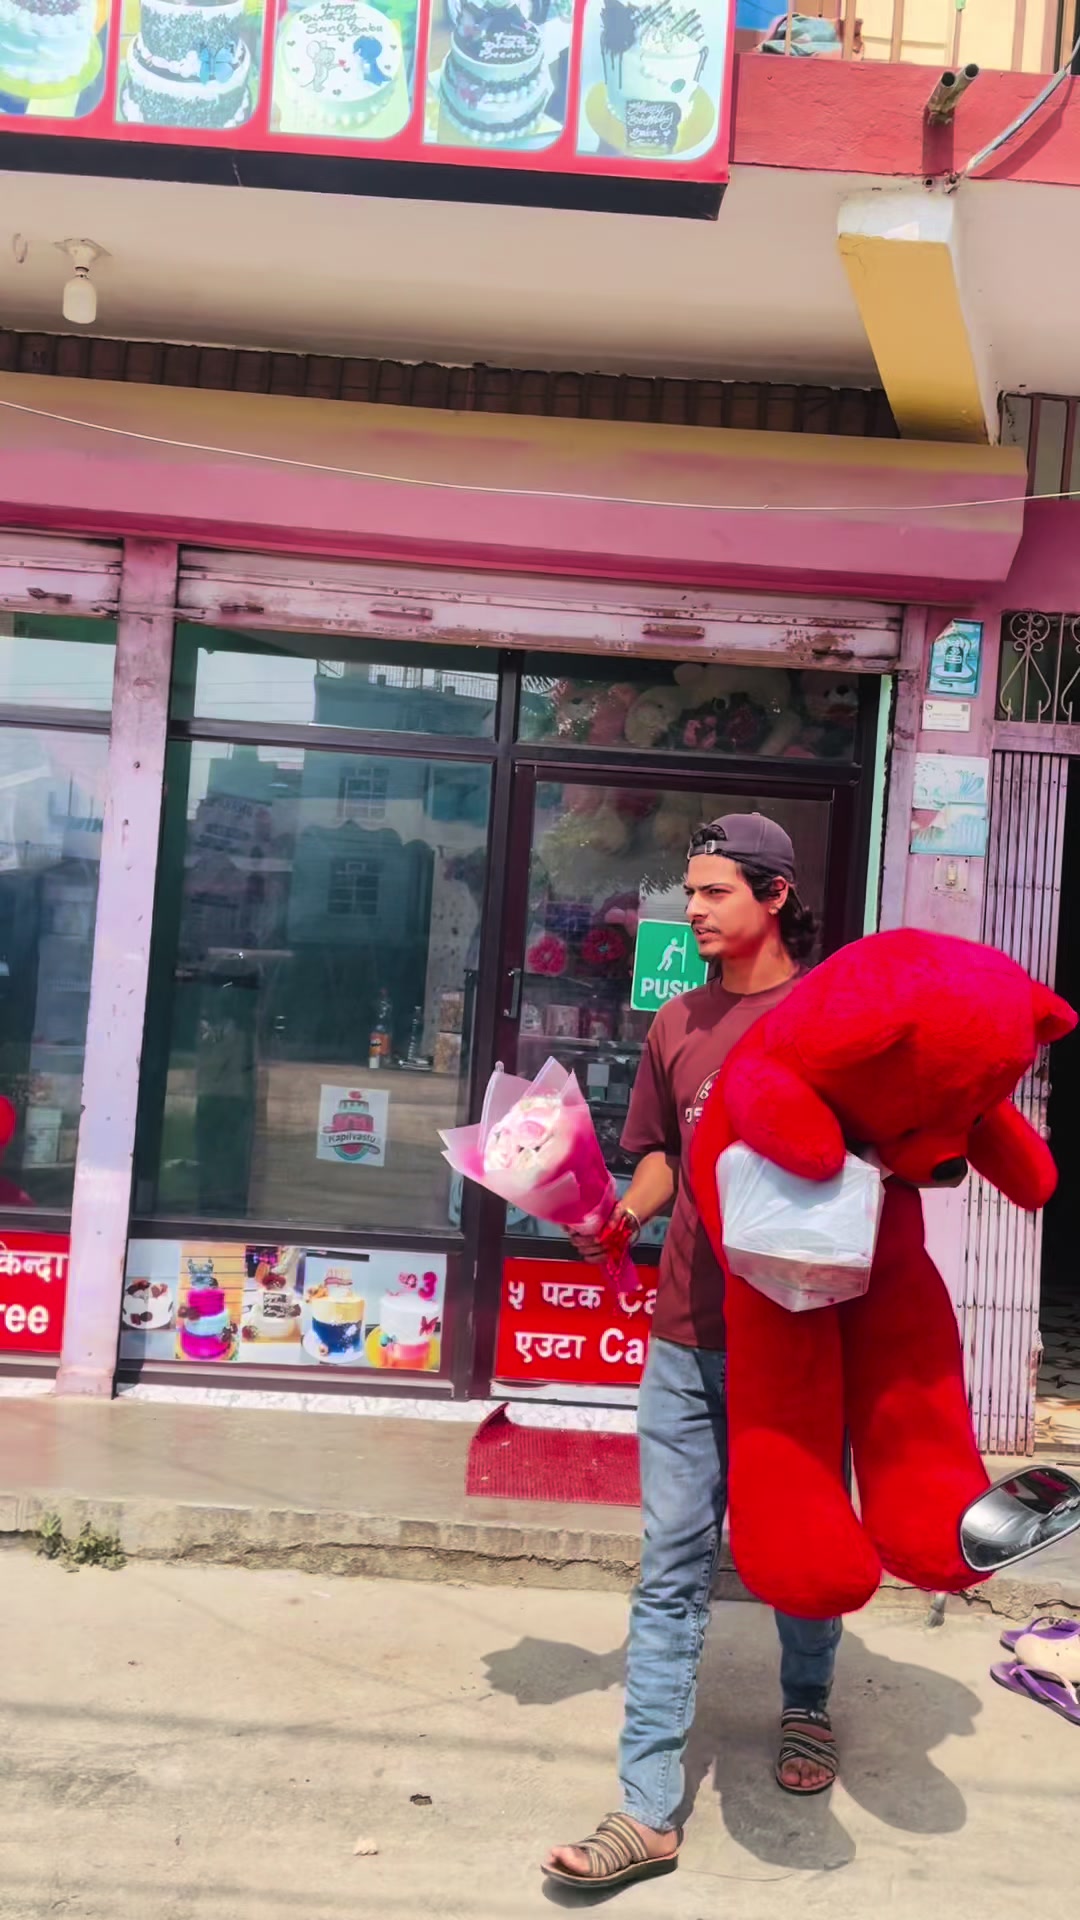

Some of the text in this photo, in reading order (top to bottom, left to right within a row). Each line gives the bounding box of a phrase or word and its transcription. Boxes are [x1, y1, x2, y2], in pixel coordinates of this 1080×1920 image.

[541, 1282, 605, 1309] पटक
[618, 1284, 657, 1315] Ca
[514, 1327, 645, 1365] एउटा Ca
